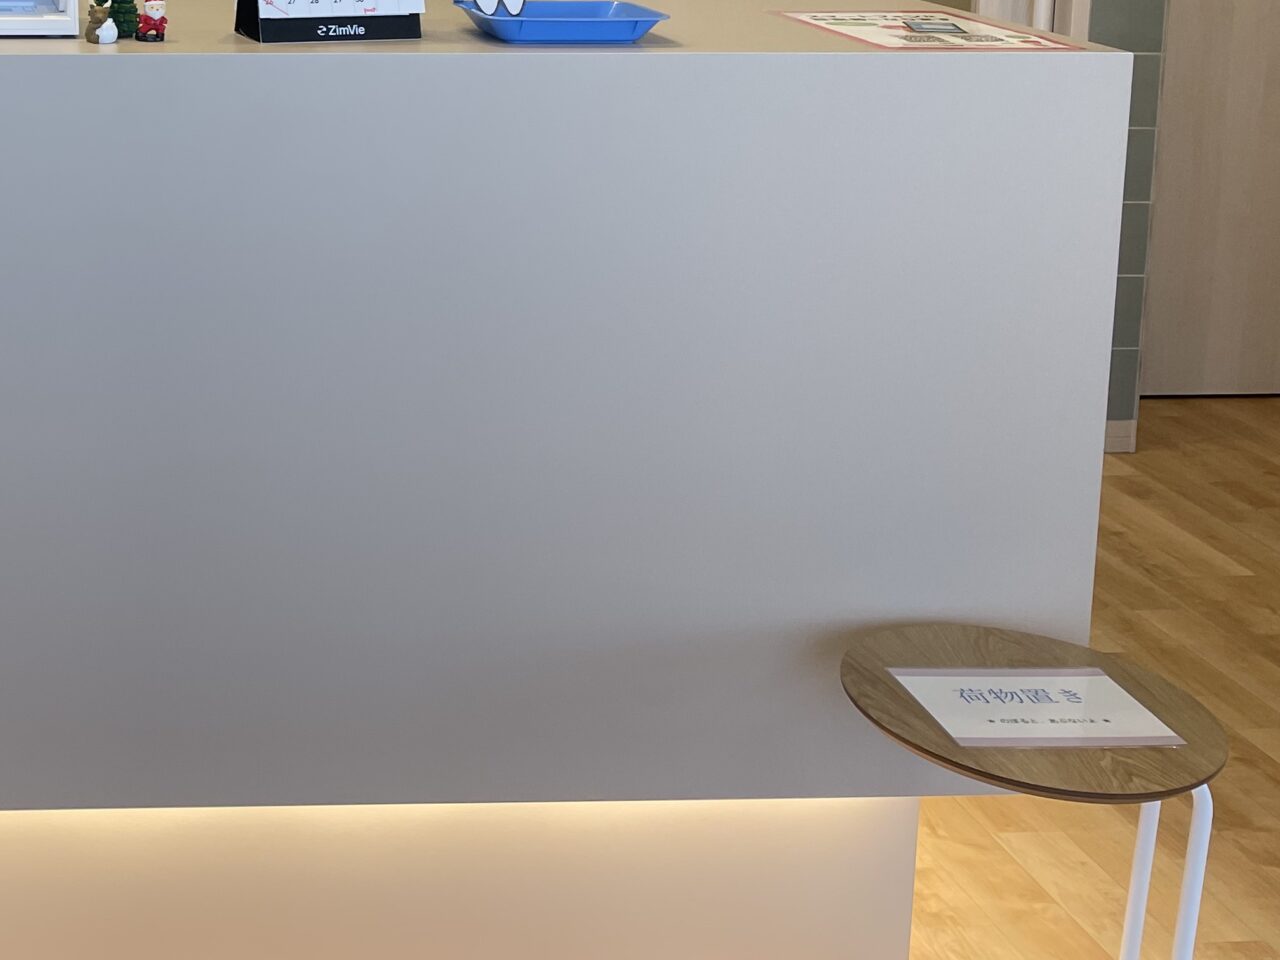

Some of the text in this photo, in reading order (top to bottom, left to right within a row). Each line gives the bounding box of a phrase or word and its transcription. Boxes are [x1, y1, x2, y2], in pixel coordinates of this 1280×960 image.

[329, 24, 365, 36] ZimVie
[953, 688, 1083, 704] 荷物置き
